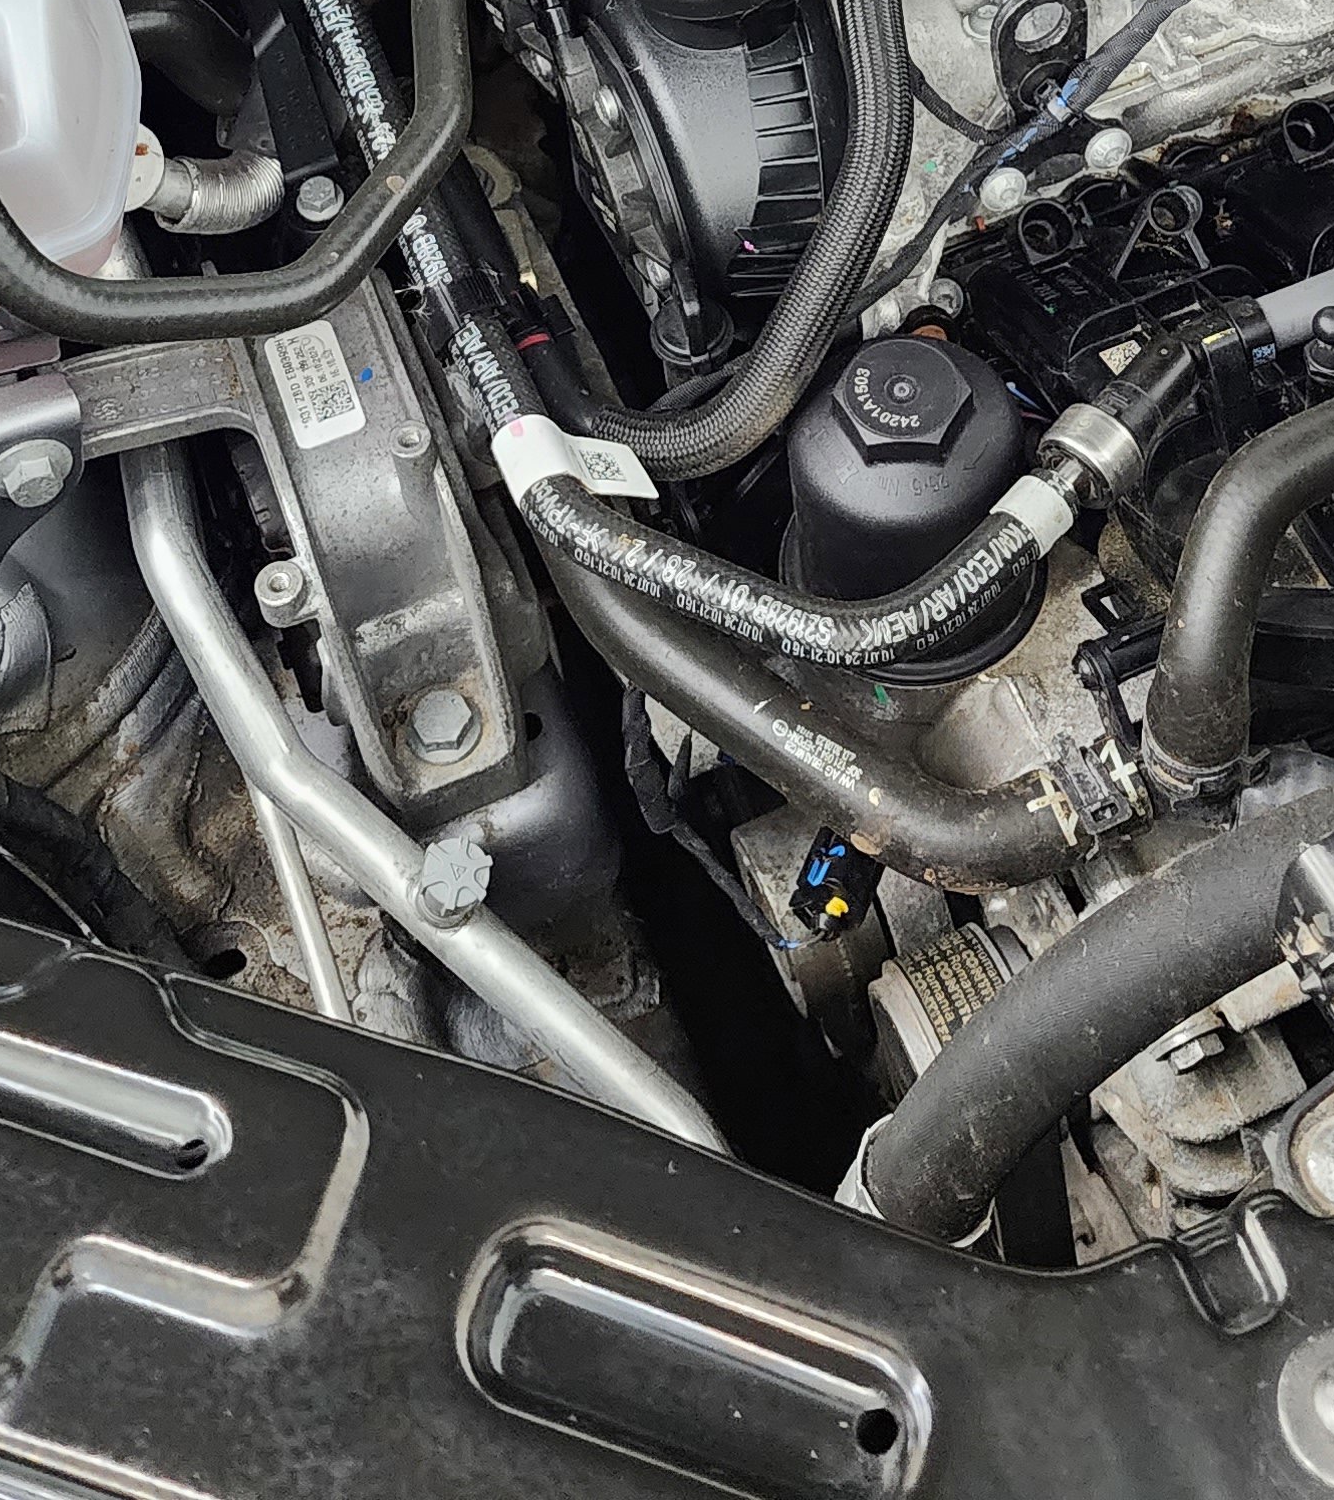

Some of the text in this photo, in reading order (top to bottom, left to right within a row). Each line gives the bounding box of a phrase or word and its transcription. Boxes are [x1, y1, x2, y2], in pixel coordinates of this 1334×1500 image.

[854, 367, 920, 427] 24201A1503
[658, 552, 696, 589] 28
[719, 578, 751, 614] 01
[749, 591, 837, 649] S21928B
[821, 763, 840, 781] AG
[921, 964, 956, 1022] Romania
[947, 953, 982, 1010] Romania
